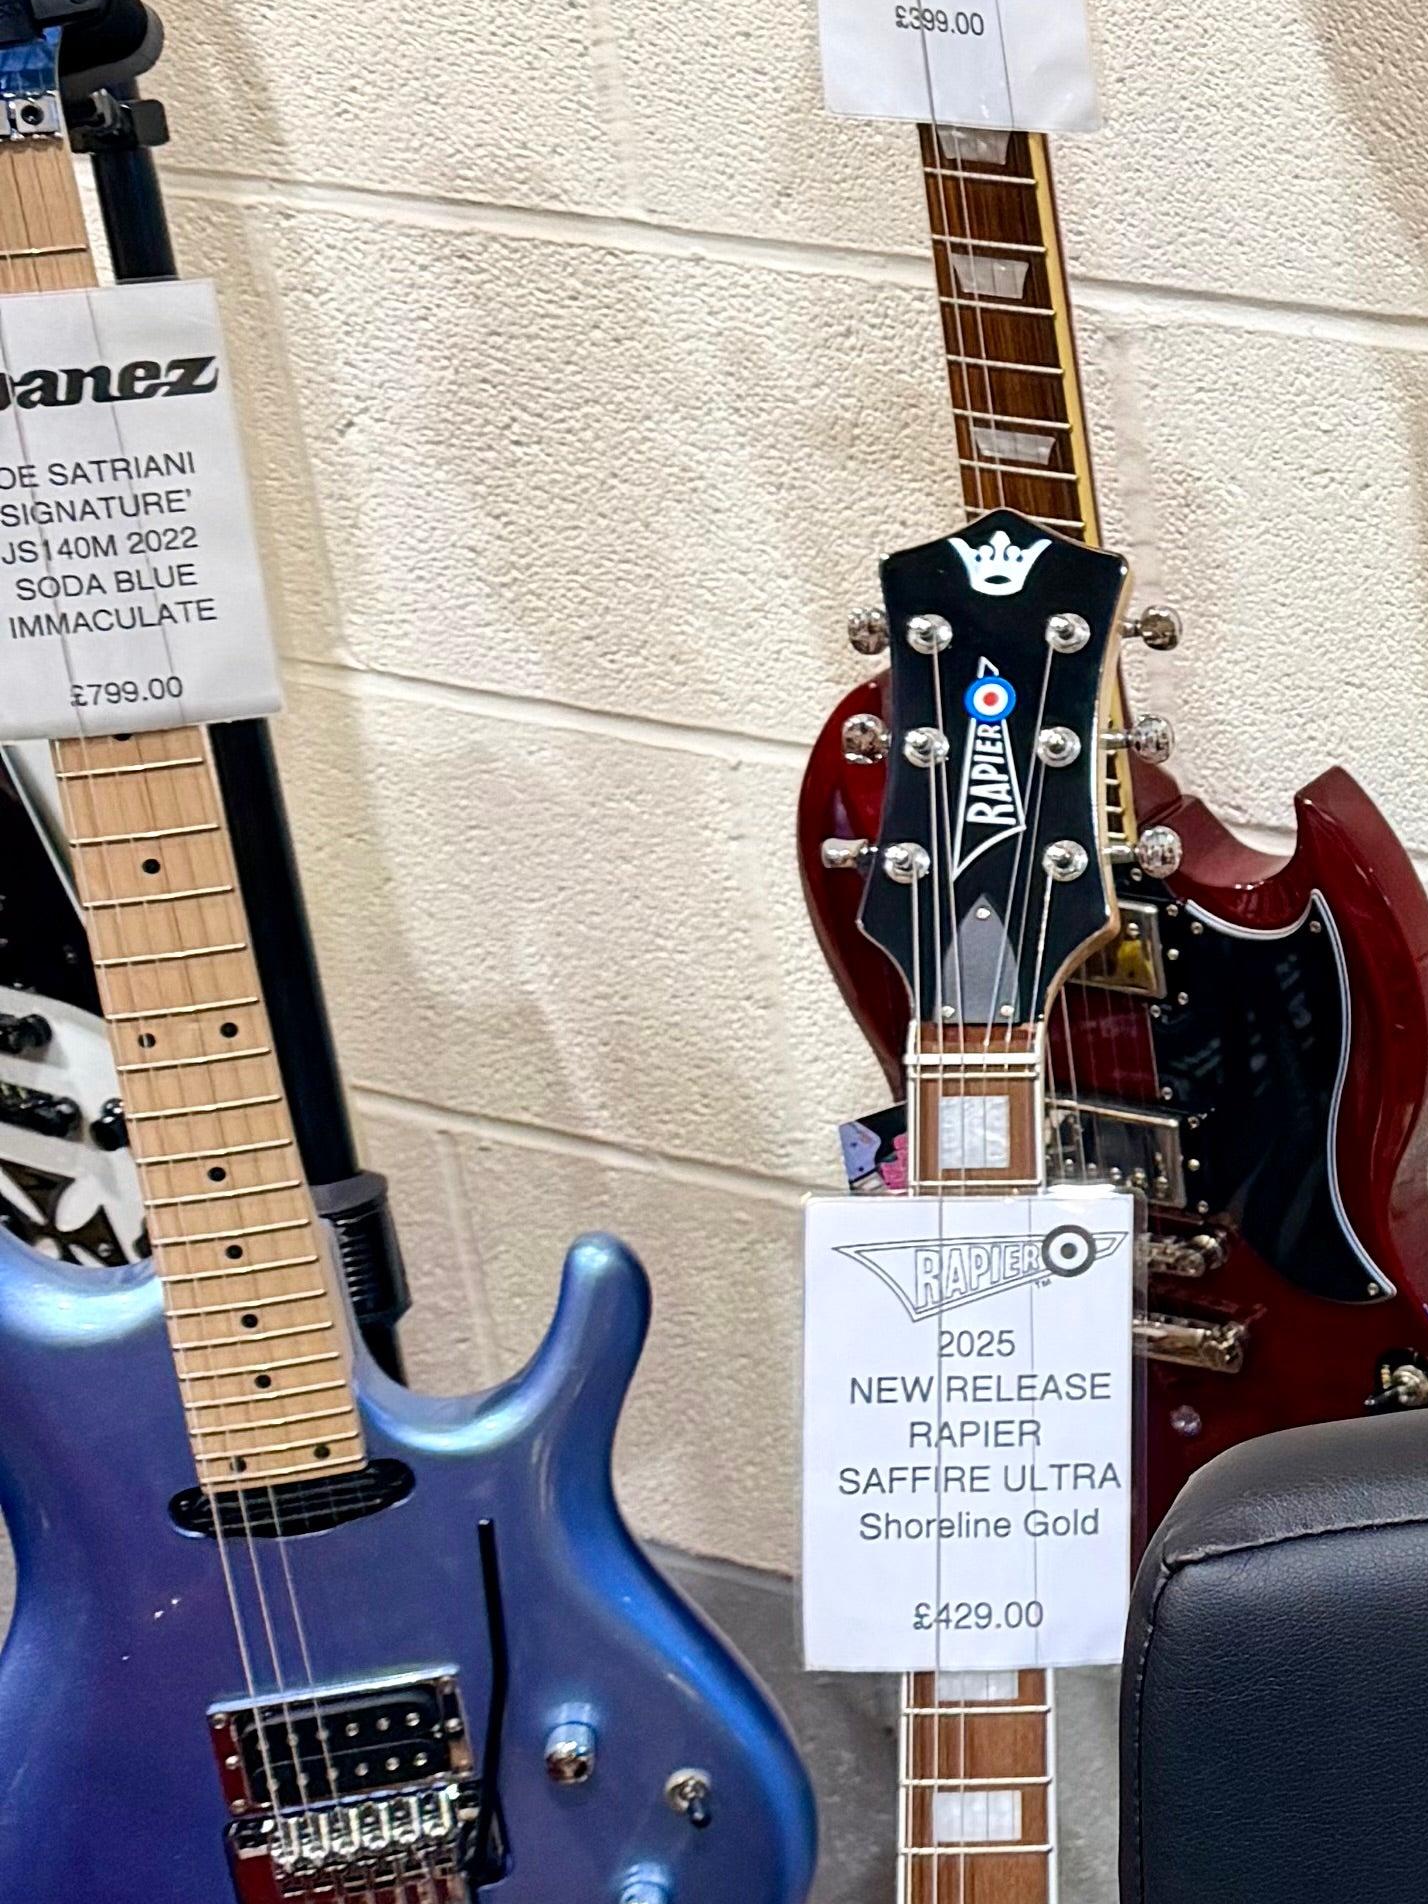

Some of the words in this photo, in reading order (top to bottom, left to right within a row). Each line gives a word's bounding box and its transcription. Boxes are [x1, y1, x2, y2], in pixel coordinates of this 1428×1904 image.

[895, 5, 985, 36] £399.00
[48, 451, 196, 487] SATRIANI
[1, 534, 118, 565] JS140M
[128, 526, 199, 555] 2022
[16, 574, 107, 601] SODA
[114, 564, 199, 593] BLUE
[9, 598, 218, 640] IMMACULATE
[70, 675, 183, 707] £799.00
[966, 724, 1016, 826] RAPIER
[914, 1243, 1041, 1311] RAPIER
[938, 1329, 1016, 1358] 2025
[850, 1376, 934, 1404] NEW
[946, 1372, 1112, 1402] RELEASE
[909, 1419, 1041, 1448] RAPIER
[838, 1465, 990, 1496] SAFFIRE
[1004, 1462, 1121, 1492] ULTRA
[859, 1511, 1012, 1541] Shoreline
[1024, 1508, 1099, 1537] Gold
[914, 1600, 1044, 1630] £429.00
